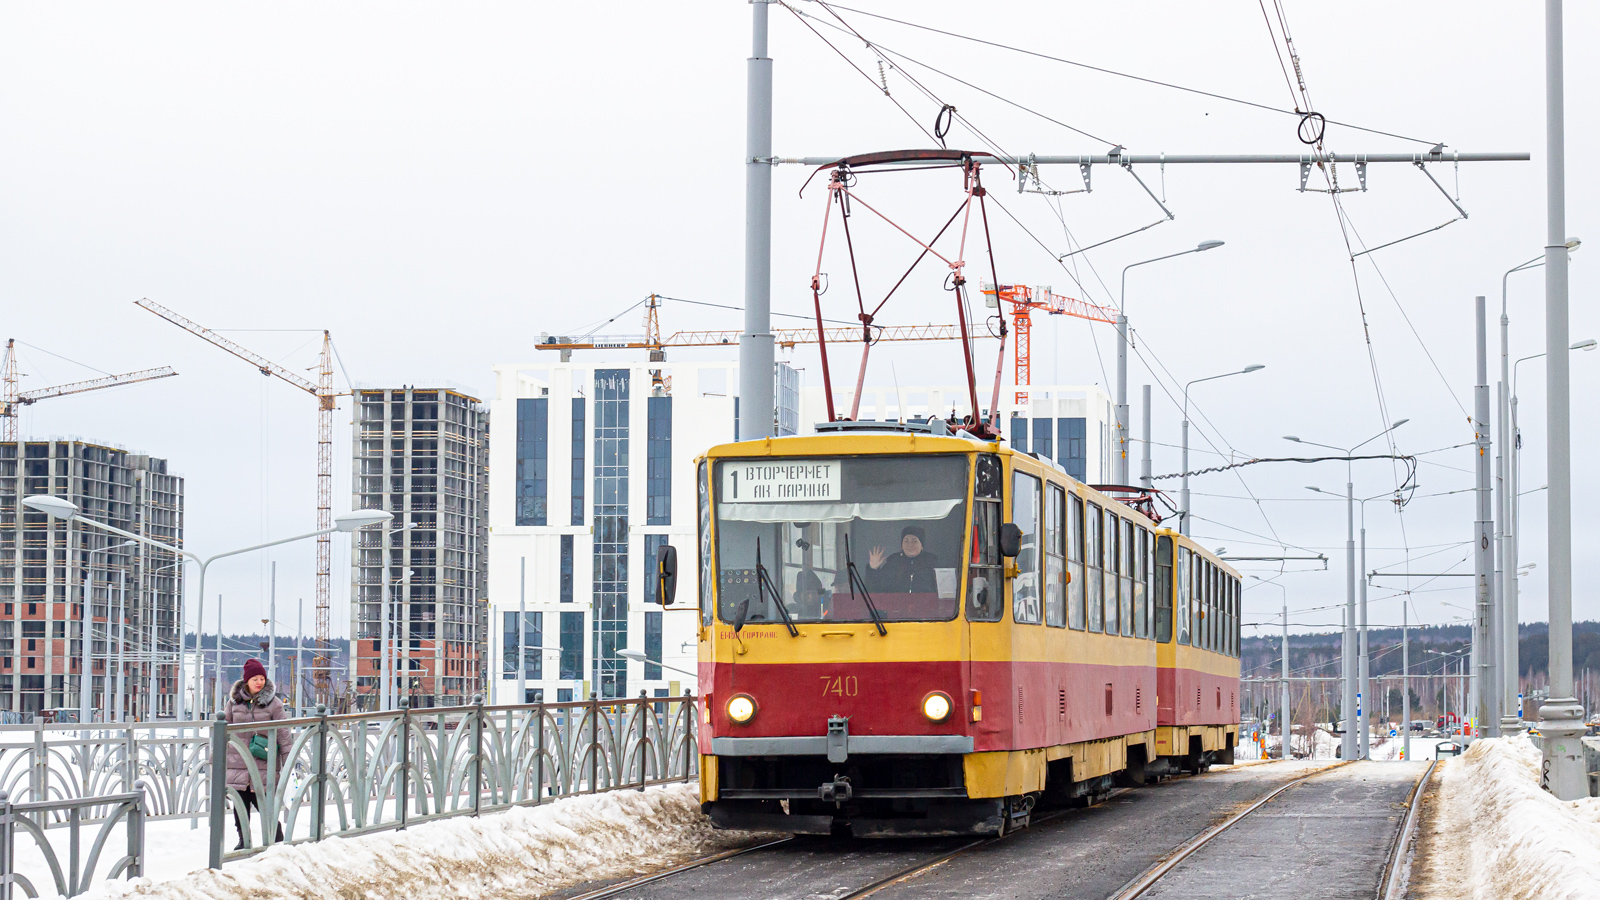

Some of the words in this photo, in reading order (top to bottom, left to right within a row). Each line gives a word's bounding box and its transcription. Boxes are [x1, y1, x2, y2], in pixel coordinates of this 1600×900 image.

[746, 465, 831, 480] ВТОРЧЕРМЕТ
[730, 470, 738, 499] 1
[820, 675, 858, 697] 740
